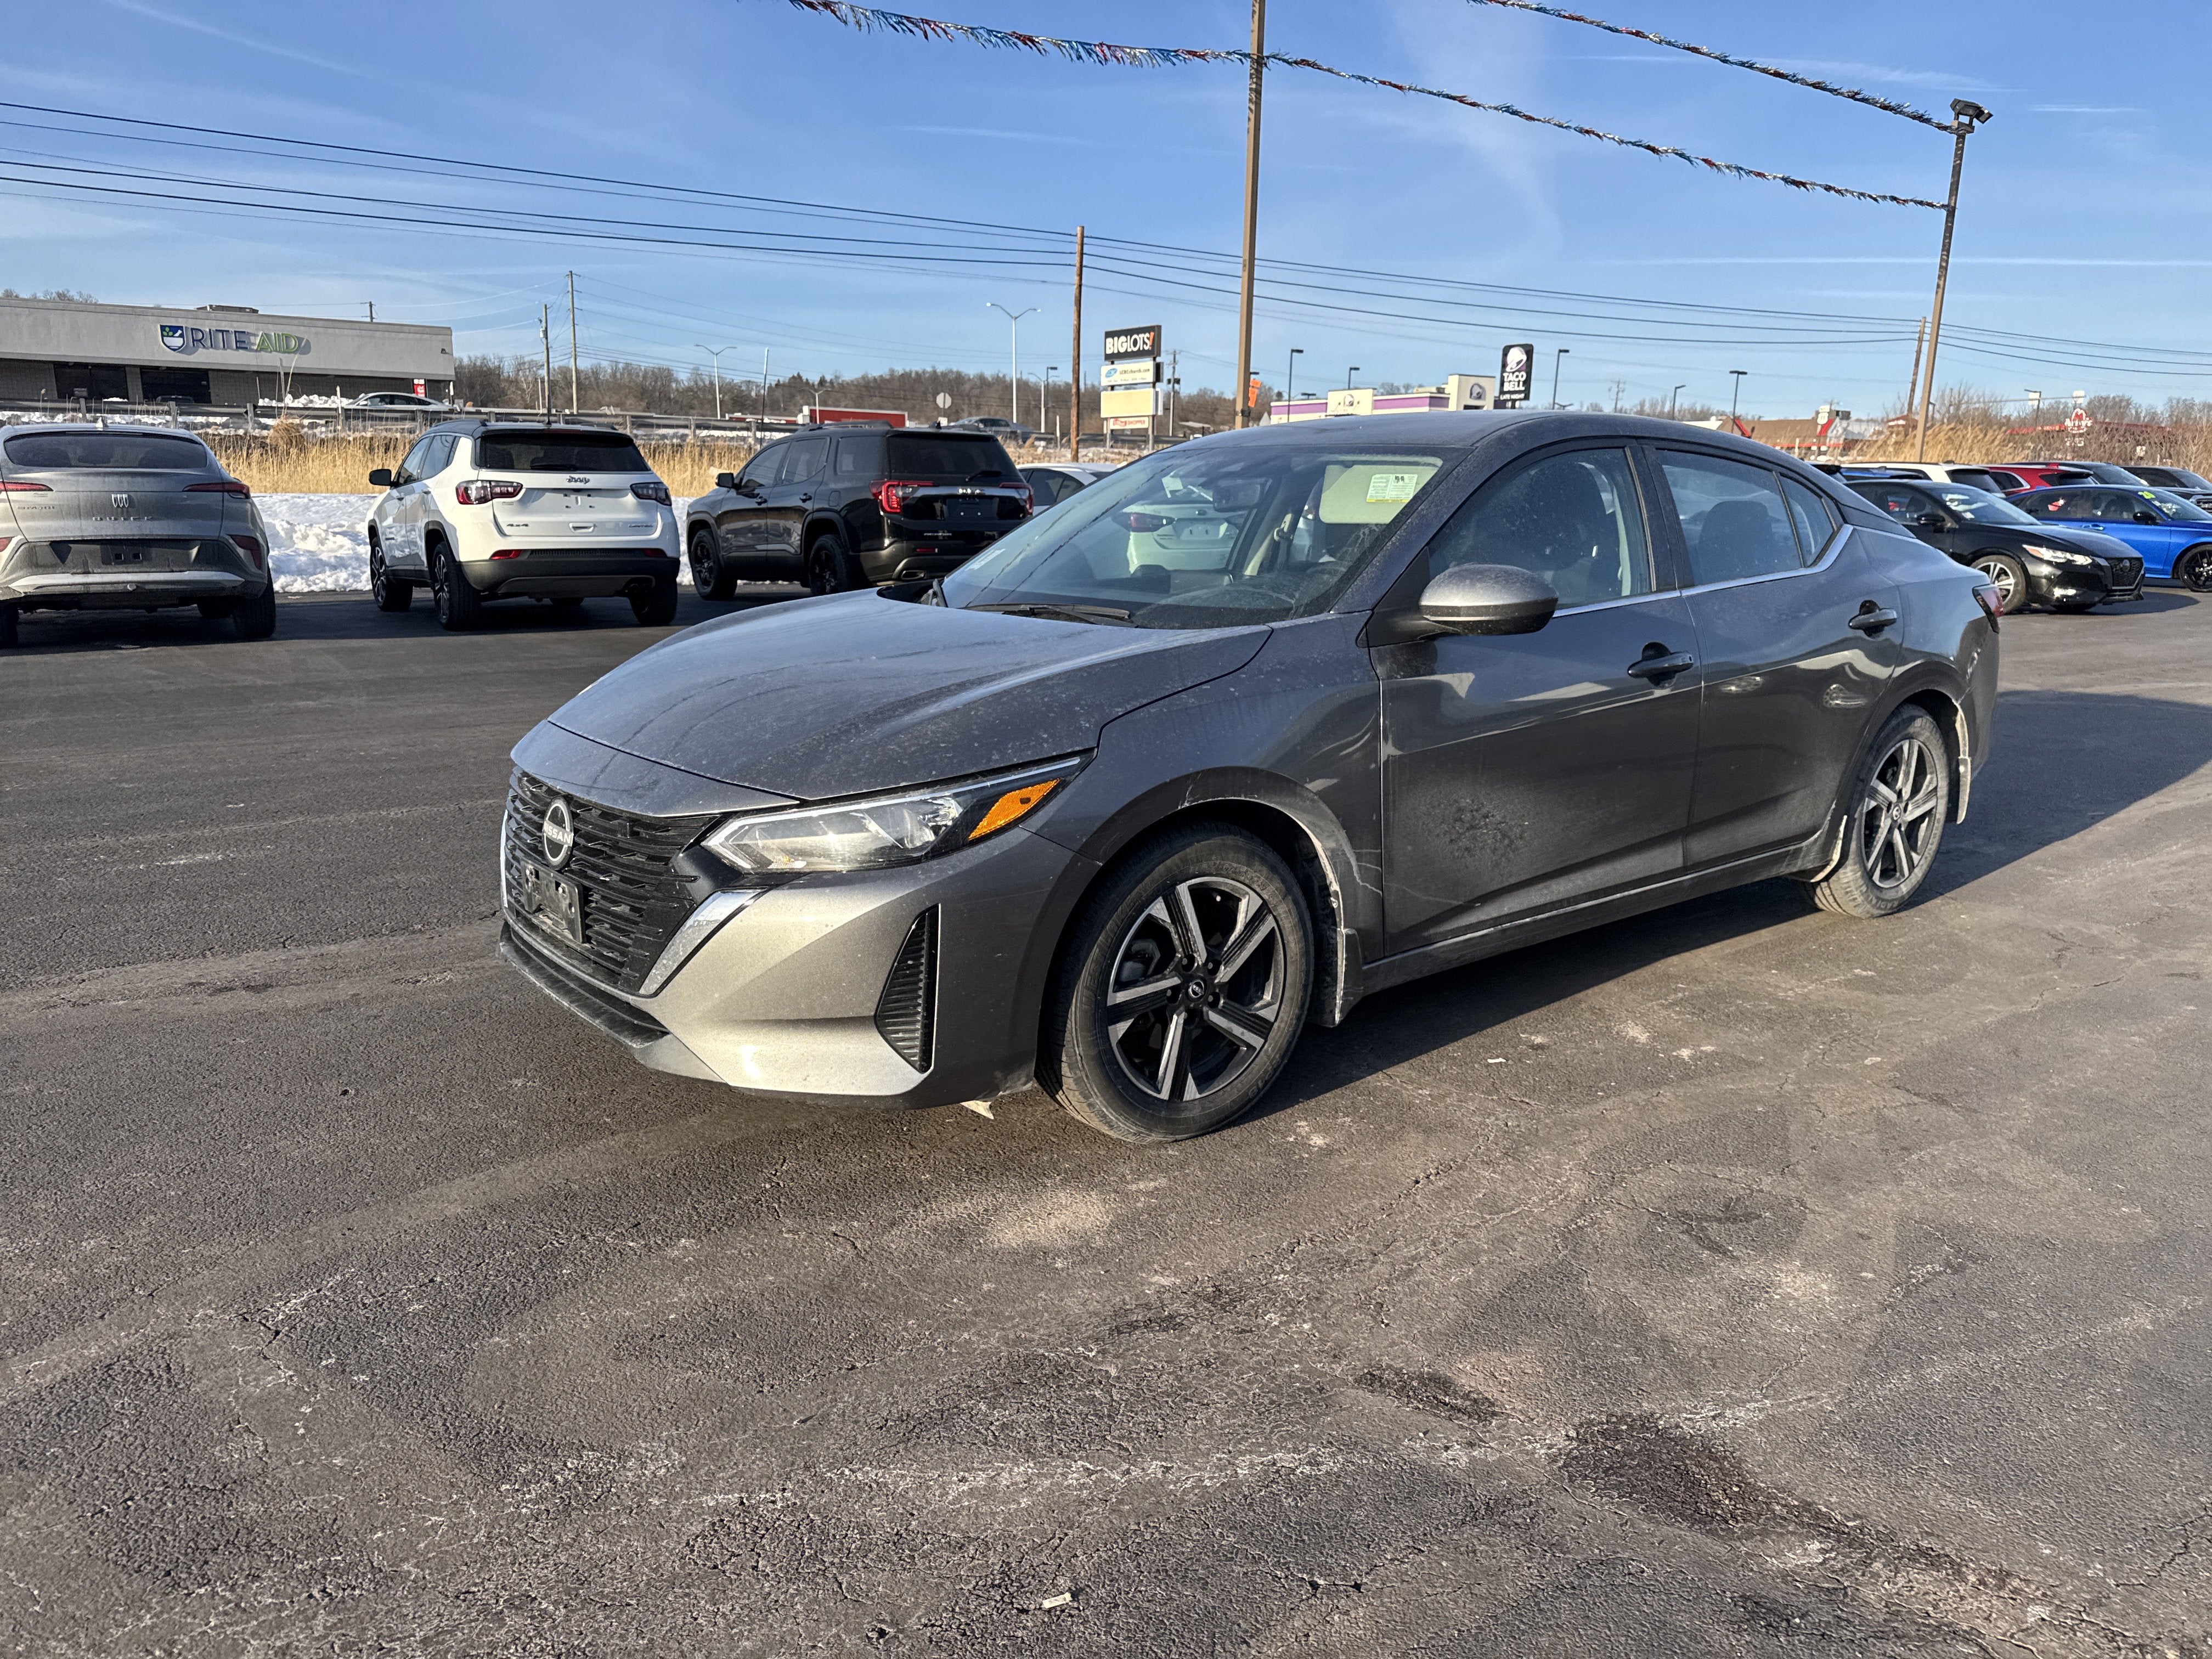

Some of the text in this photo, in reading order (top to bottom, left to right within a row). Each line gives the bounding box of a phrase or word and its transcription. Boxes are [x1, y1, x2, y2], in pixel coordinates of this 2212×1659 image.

[190, 328, 298, 352] RITE AID
[1503, 371, 1526, 382] TACO
[1504, 381, 1525, 391] BELL
[543, 820, 572, 844] NISSAN
